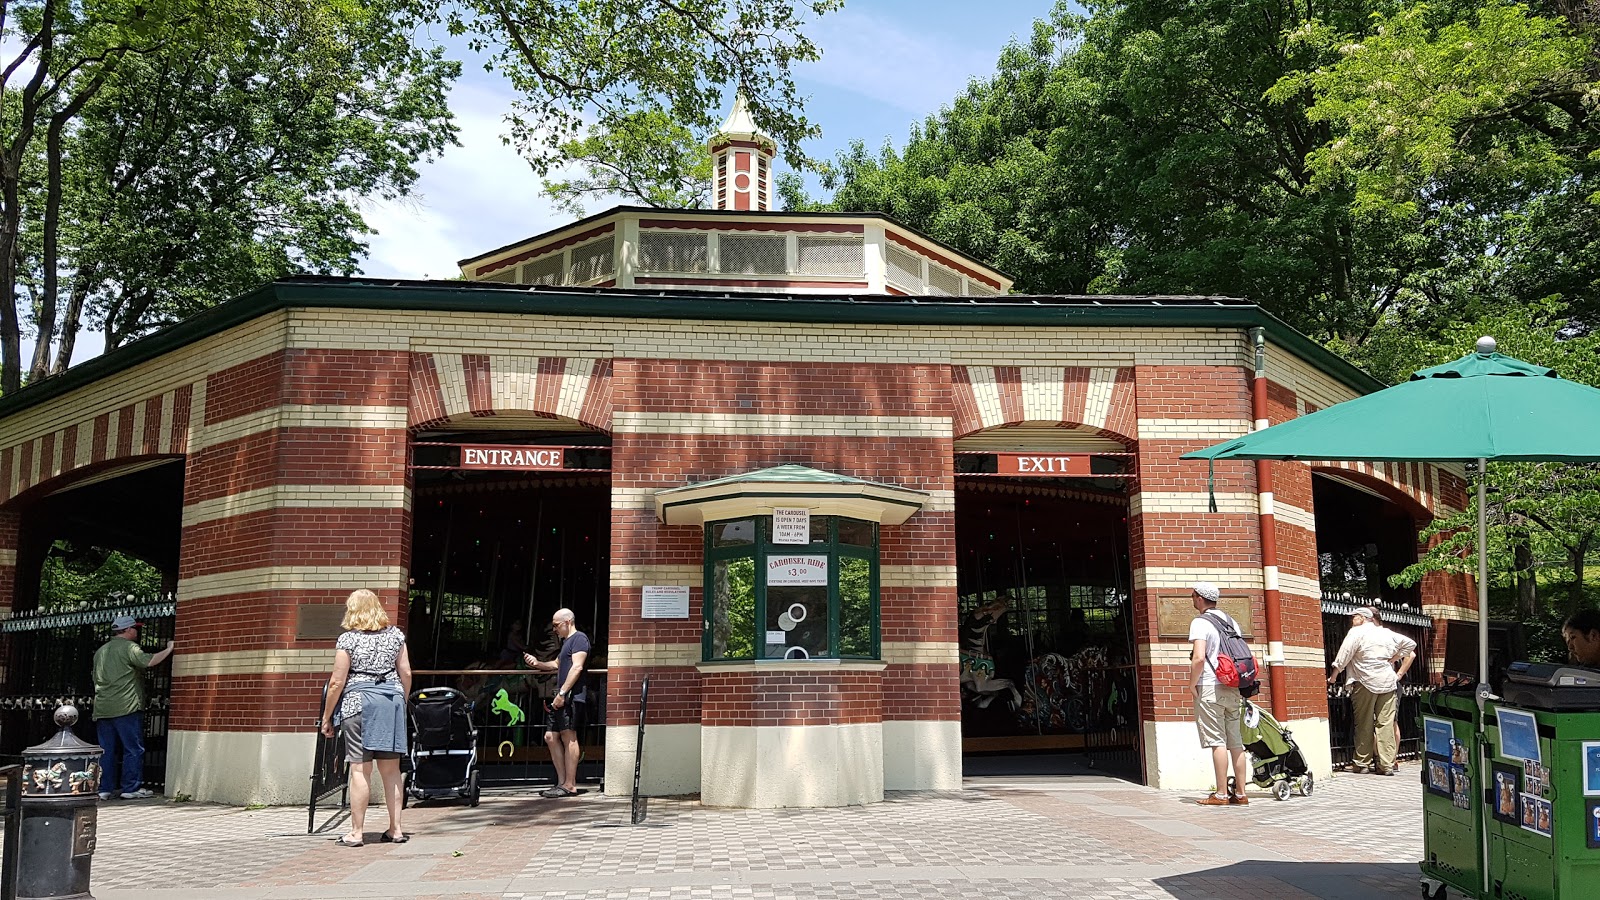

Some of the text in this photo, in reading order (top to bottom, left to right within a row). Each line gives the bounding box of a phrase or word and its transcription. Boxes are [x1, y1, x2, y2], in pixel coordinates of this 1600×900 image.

[464, 449, 561, 466] ENTRANCE
[1017, 457, 1071, 472] EXIT
[769, 558, 825, 569] CAROUSEL RIDE
